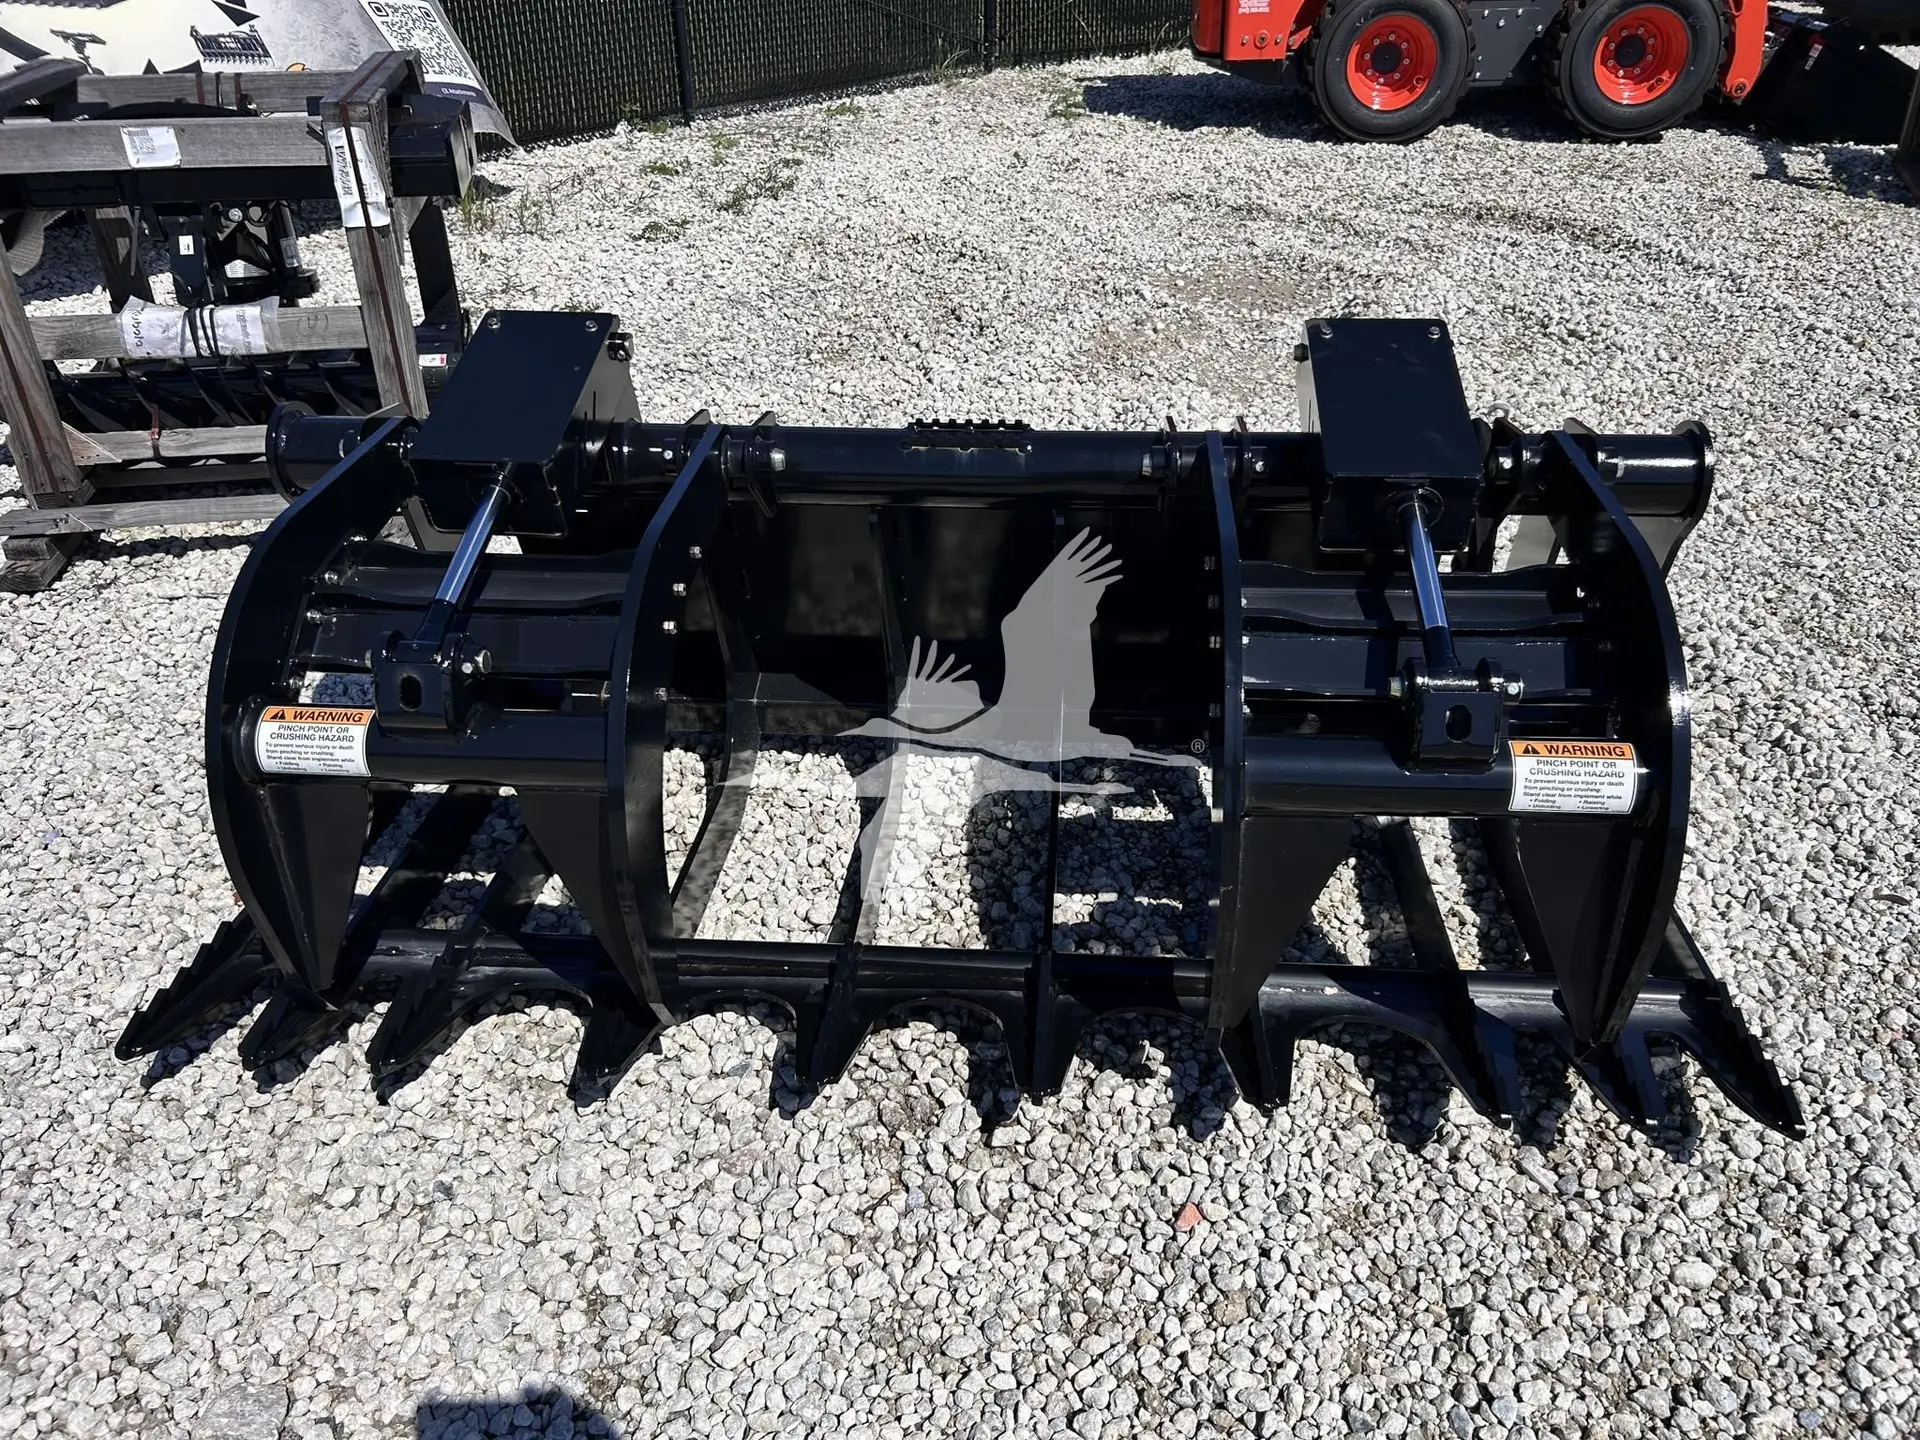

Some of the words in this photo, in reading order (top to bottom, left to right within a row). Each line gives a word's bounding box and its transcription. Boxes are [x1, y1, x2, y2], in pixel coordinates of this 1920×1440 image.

[292, 710, 364, 723] WARNING
[278, 724, 306, 733] PINCH
[307, 725, 335, 734] POINT
[336, 726, 350, 735] OR
[270, 732, 316, 742] CRUSHING
[318, 734, 355, 743] HAZARD
[1544, 744, 1626, 757] WARNING
[1536, 759, 1567, 768] PINCH
[1569, 760, 1600, 769] POINT
[1601, 761, 1617, 769] OR
[1529, 767, 1582, 777] CRUSHING
[1583, 769, 1625, 779] HAZARD
